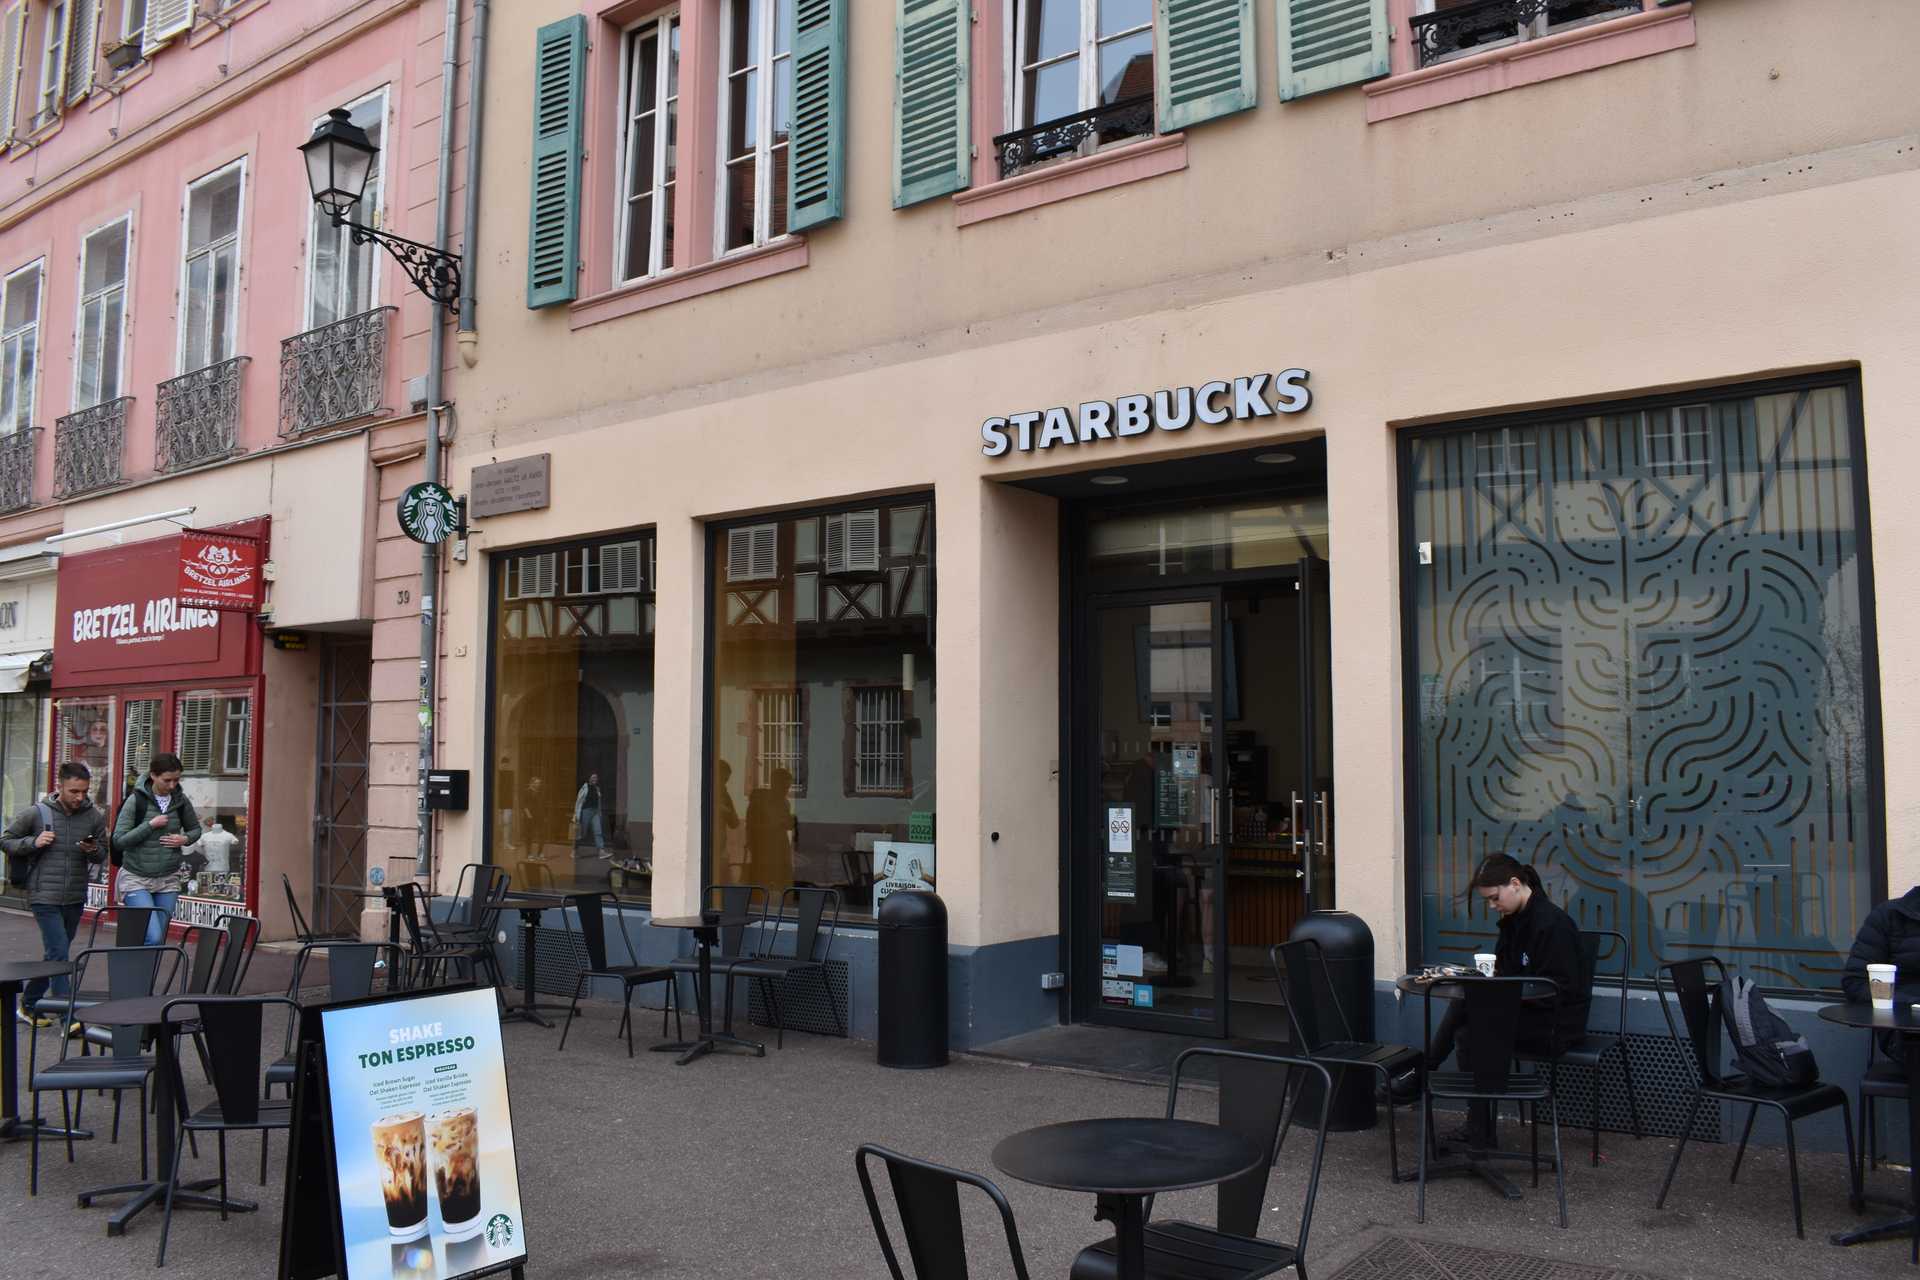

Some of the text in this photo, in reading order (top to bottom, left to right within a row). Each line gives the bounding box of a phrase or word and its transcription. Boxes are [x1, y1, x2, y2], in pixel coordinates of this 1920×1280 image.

[981, 367, 1312, 457] STARBUCKS
[184, 566, 250, 587] BRETZEL AIRLINES
[397, 590, 410, 605] 39
[73, 597, 219, 643] BRETZEL AIRLINES
[911, 824, 932, 835] 2022
[886, 881, 916, 889] LIVRAISON
[389, 1022, 443, 1044] SHAKE
[358, 1036, 475, 1069] TON ESPRESSO
